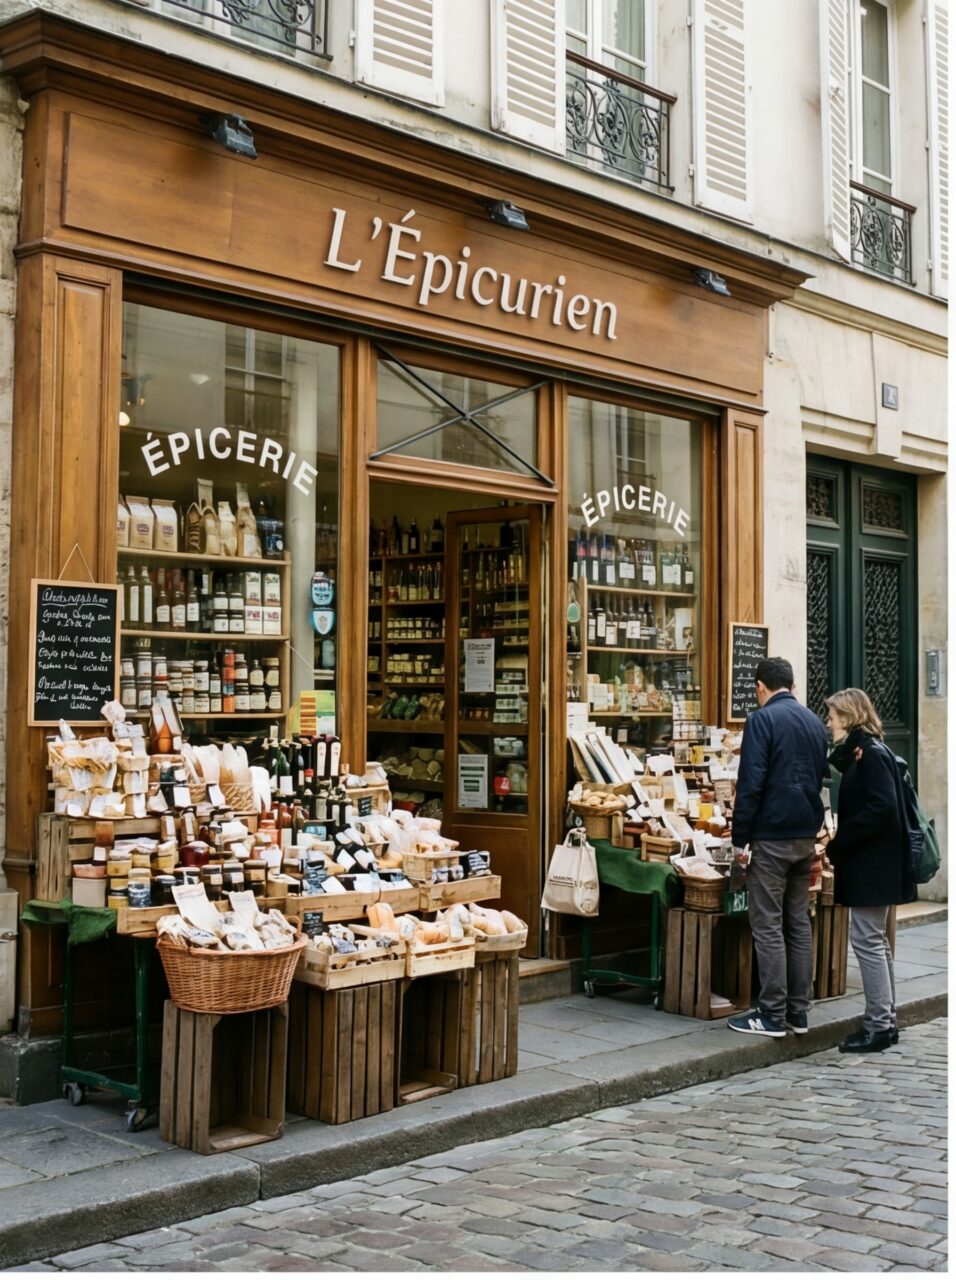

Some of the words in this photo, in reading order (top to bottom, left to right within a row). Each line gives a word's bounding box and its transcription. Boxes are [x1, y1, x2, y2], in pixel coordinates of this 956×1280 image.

[323, 207, 618, 340] L'Épicurien
[141, 427, 318, 496] ÉPICERIE
[580, 484, 691, 537] ÉPICERIE
